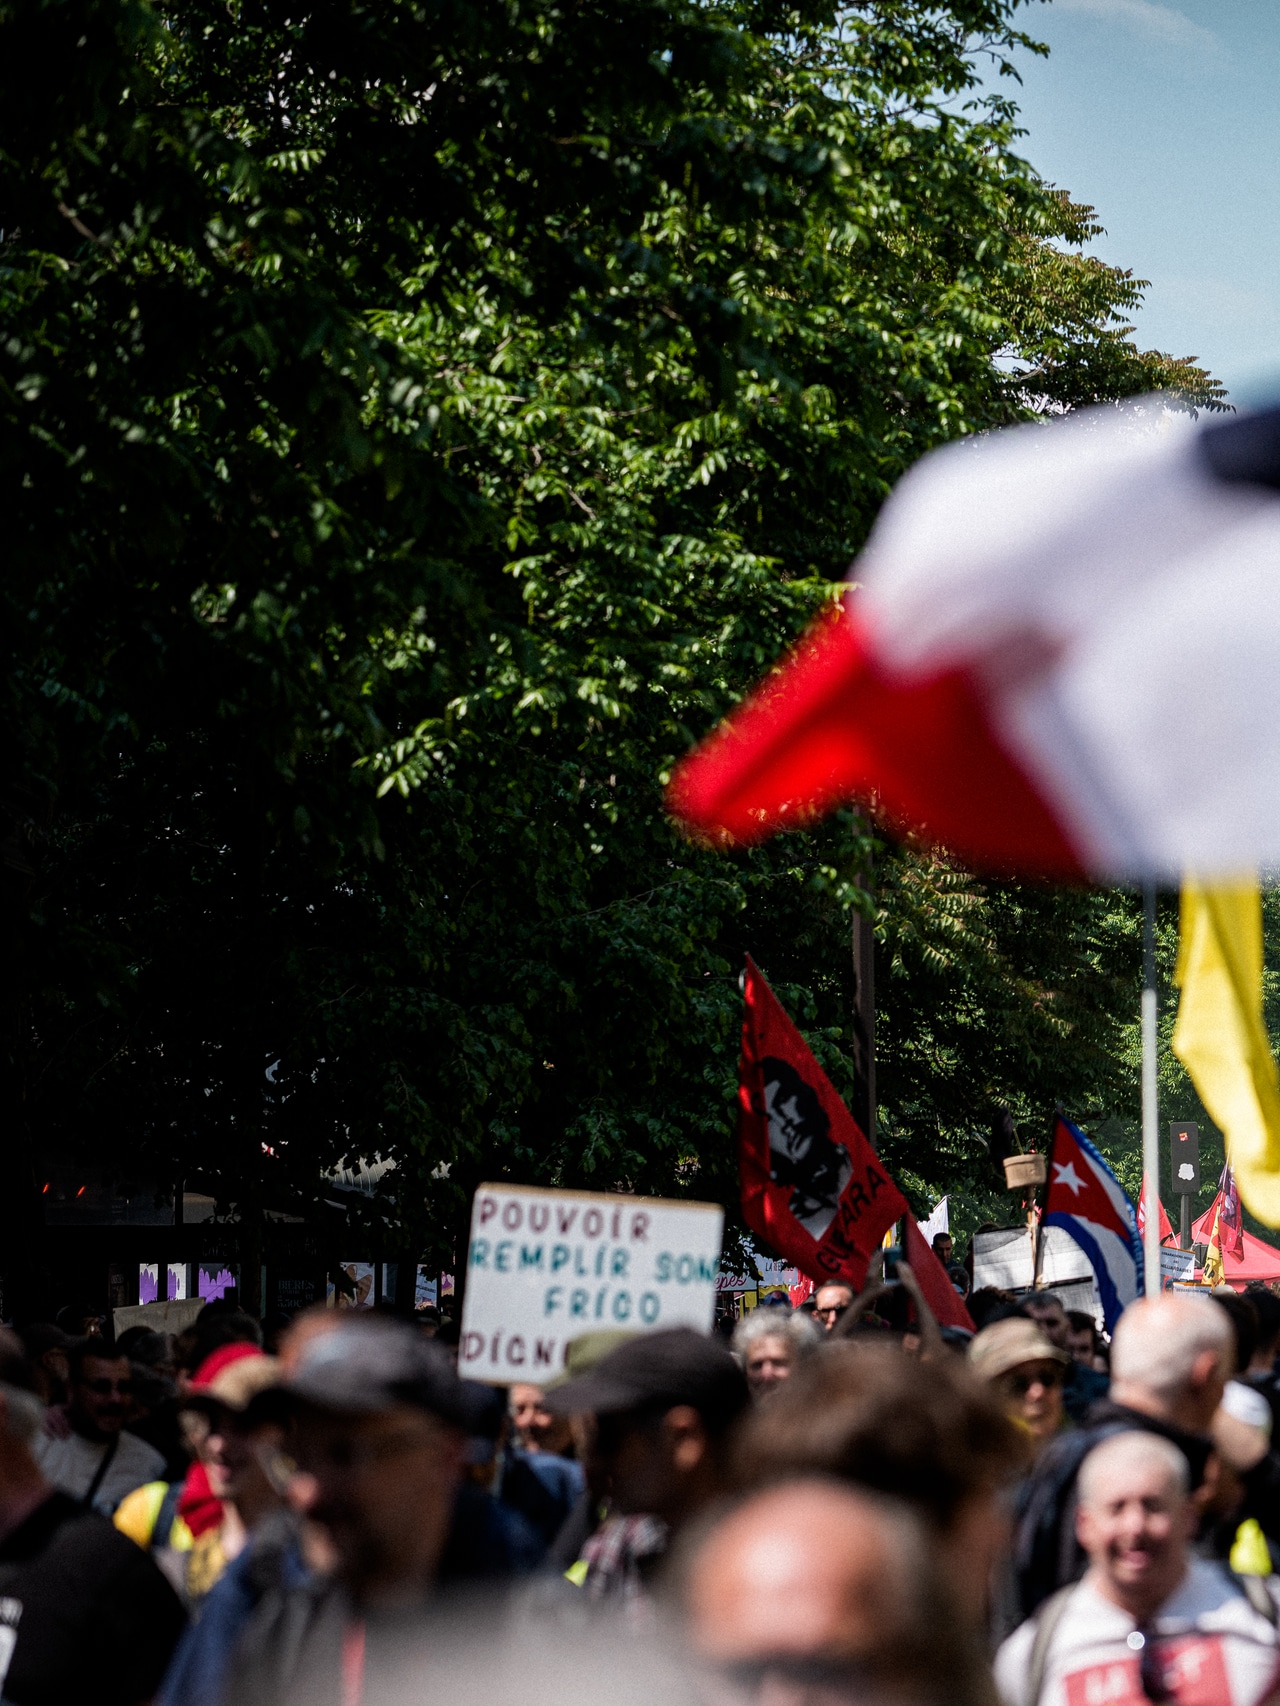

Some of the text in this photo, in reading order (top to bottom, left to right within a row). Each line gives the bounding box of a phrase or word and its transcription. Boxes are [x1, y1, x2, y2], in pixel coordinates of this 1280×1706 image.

[479, 1198, 650, 1242] POUVOIR
[469, 1237, 720, 1286] REMPLIR SON
[714, 1273, 747, 1291] epes
